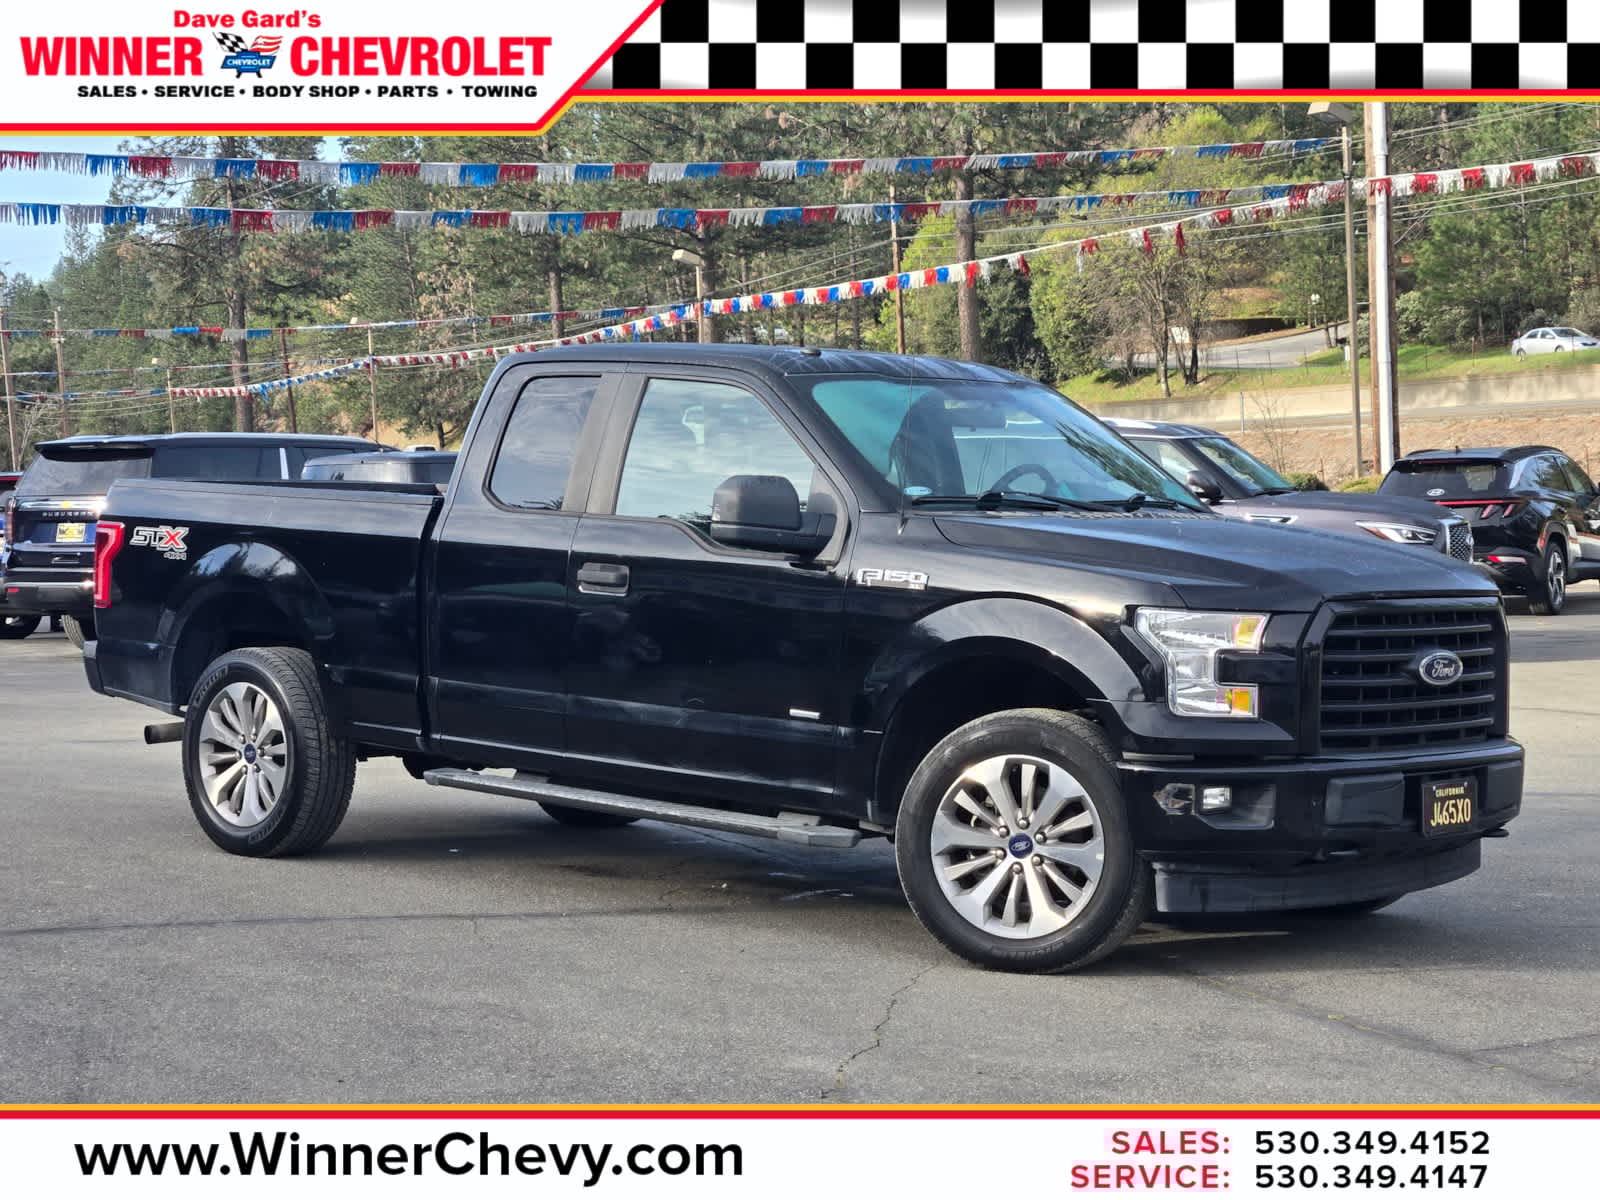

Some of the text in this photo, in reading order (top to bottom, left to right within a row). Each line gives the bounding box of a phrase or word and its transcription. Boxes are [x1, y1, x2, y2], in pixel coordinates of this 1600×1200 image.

[129, 525, 189, 552] STX
[1432, 659, 1455, 677] Ford
[1435, 786, 1464, 797] CALIFORNIA
